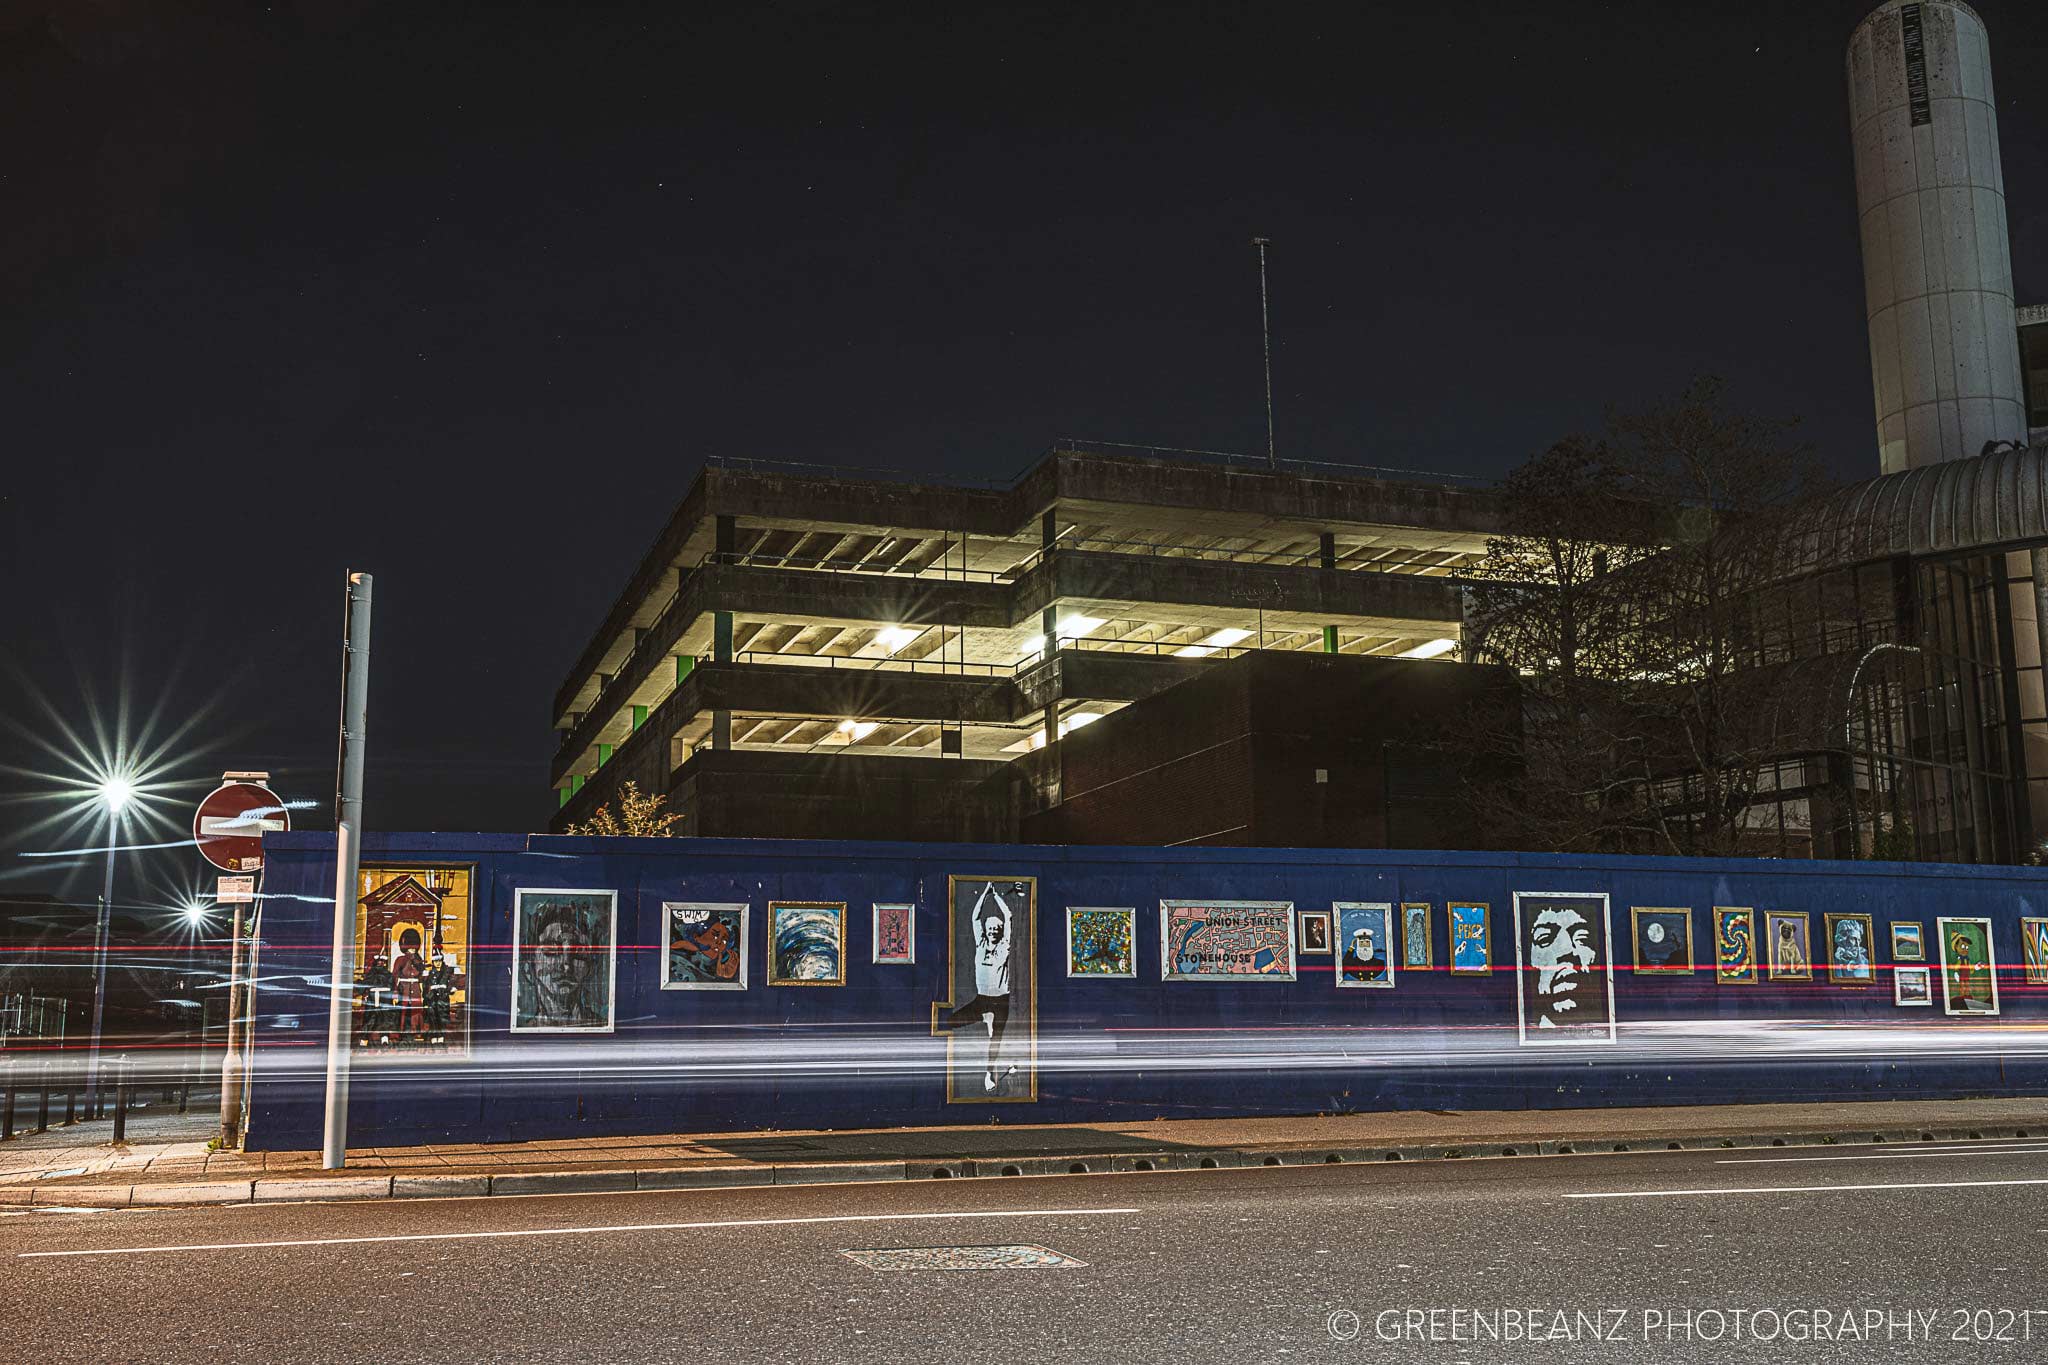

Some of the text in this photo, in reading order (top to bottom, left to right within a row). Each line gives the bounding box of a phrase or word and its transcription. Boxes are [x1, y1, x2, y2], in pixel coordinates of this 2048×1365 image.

[1205, 916, 1281, 927] UNION STREET
[1176, 953, 1251, 964] STONEHOUSE
